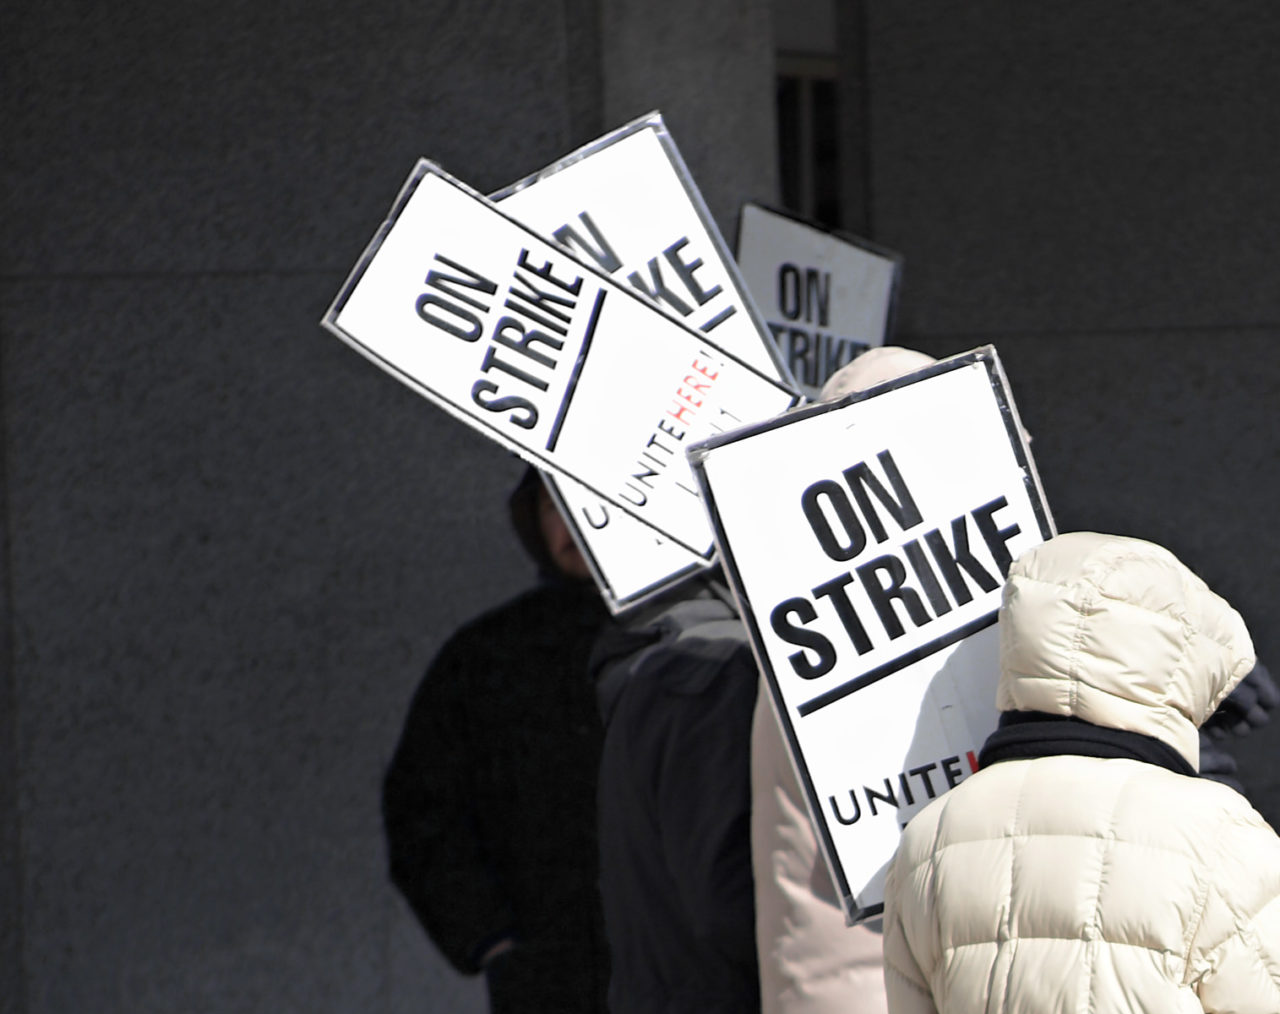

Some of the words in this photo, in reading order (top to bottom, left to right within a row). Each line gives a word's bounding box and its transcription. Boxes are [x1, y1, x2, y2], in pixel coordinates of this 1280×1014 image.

[552, 211, 624, 274] N
[415, 253, 498, 343] ON
[471, 247, 584, 430] STRIKE
[778, 263, 831, 328] ON
[800, 449, 924, 562] ON
[769, 494, 1022, 680] STRIKE
